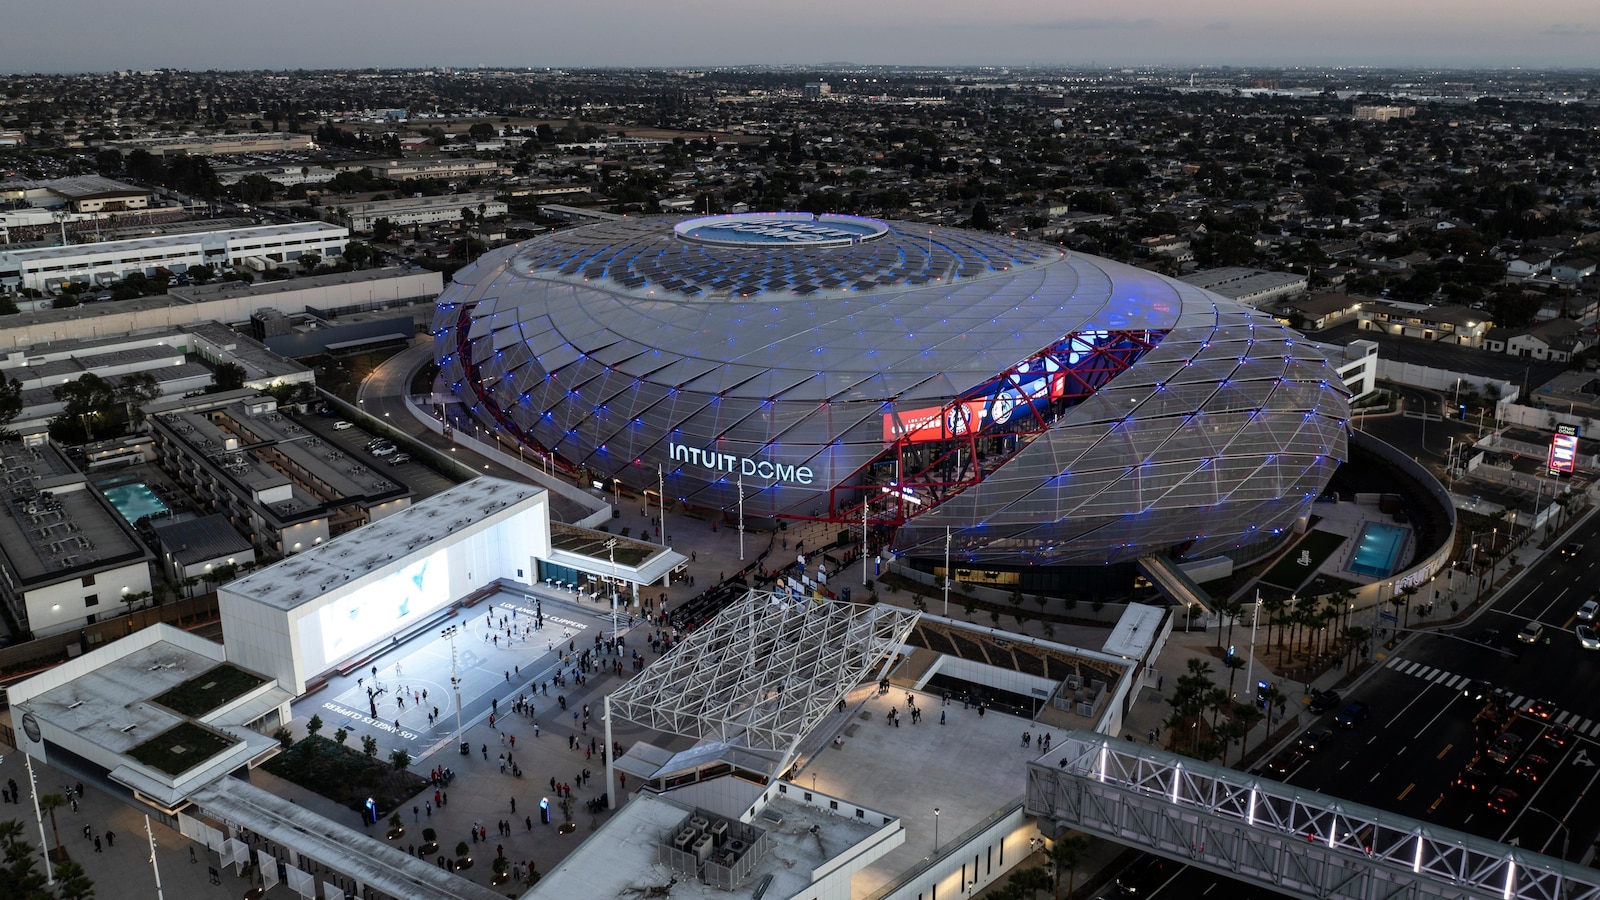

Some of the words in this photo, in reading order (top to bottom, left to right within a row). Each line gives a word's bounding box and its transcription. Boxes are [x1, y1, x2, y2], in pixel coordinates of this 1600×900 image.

[500, 602, 517, 610] LOS
[550, 615, 588, 630] CLIPPERS
[322, 702, 362, 720] CLIPPERS
[398, 730, 418, 741] LOS
